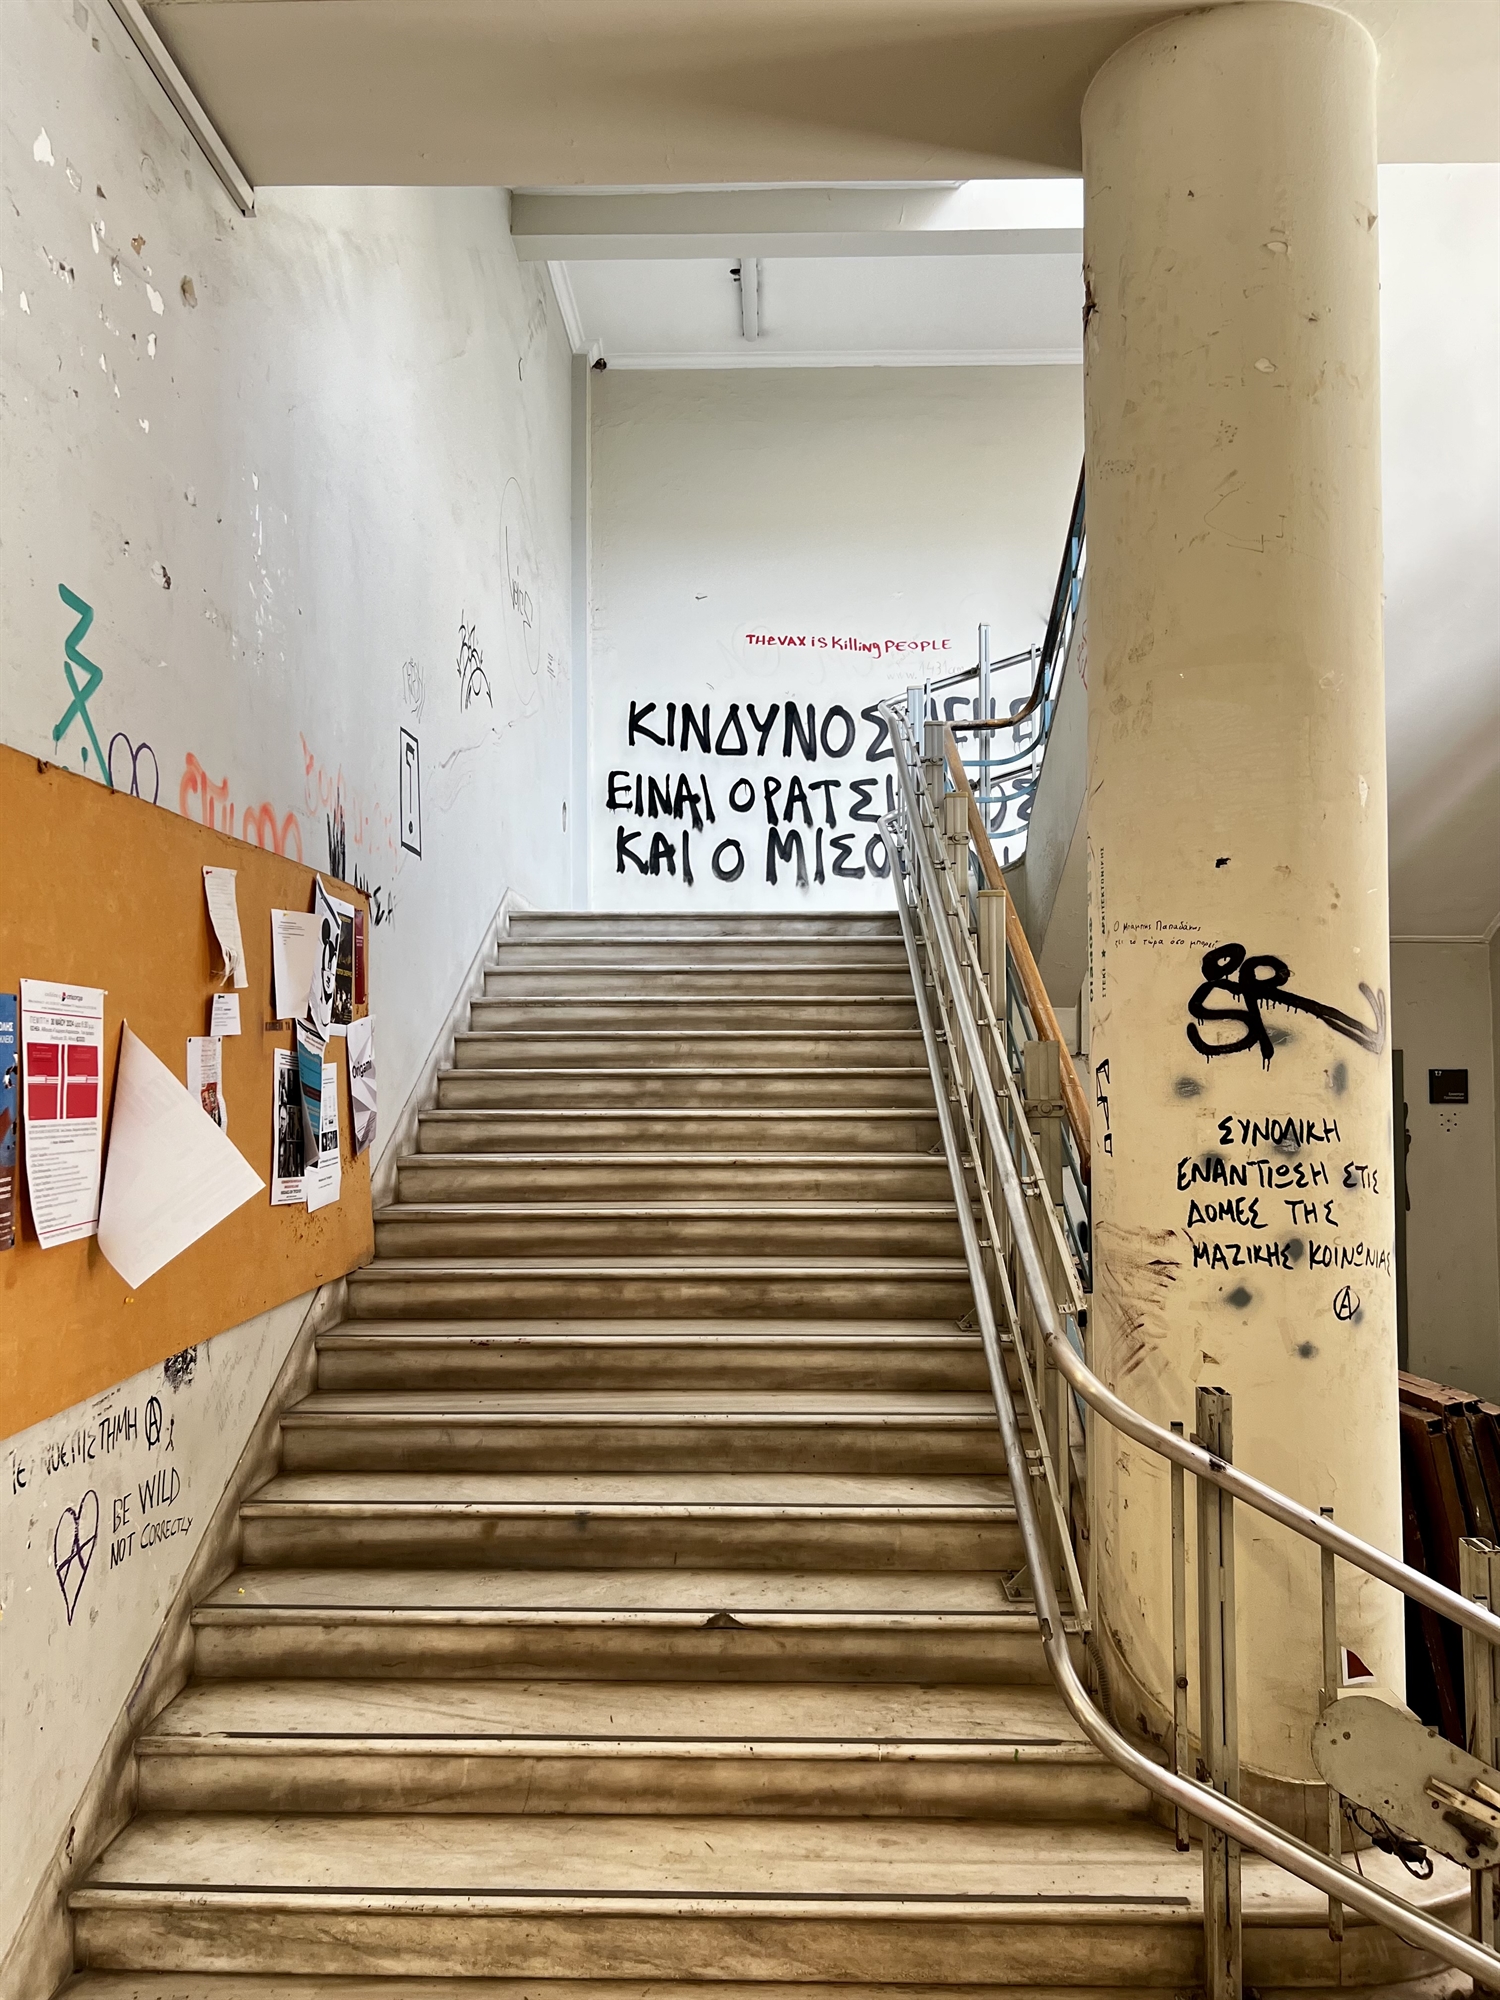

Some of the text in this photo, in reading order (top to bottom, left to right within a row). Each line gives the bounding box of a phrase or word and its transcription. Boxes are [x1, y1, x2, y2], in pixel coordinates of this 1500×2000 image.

[831, 636, 882, 659] Killing
[885, 638, 953, 653] PEOPLE
[627, 700, 895, 762] ΚΙΝΔΥΝΟΣ
[605, 770, 717, 832] ΕΙΝΑΙ
[616, 826, 694, 886] ΚΑΙ
[711, 838, 744, 882] Ο
[1217, 1116, 1341, 1146] ΣΥΝΟΛΙΚΗ
[1176, 1157, 1379, 1195] ΕΝΑΝΤΙΩΣΗ ΣΤΙΣ
[1187, 1199, 1339, 1229] ΔΟΜΕΣ ΤΗΣ
[1192, 1242, 1295, 1270] ΜΑΖΙΚΗΣ
[112, 1467, 181, 1534] BE WILD
[110, 1516, 194, 1570] NOT CORRECTLY
